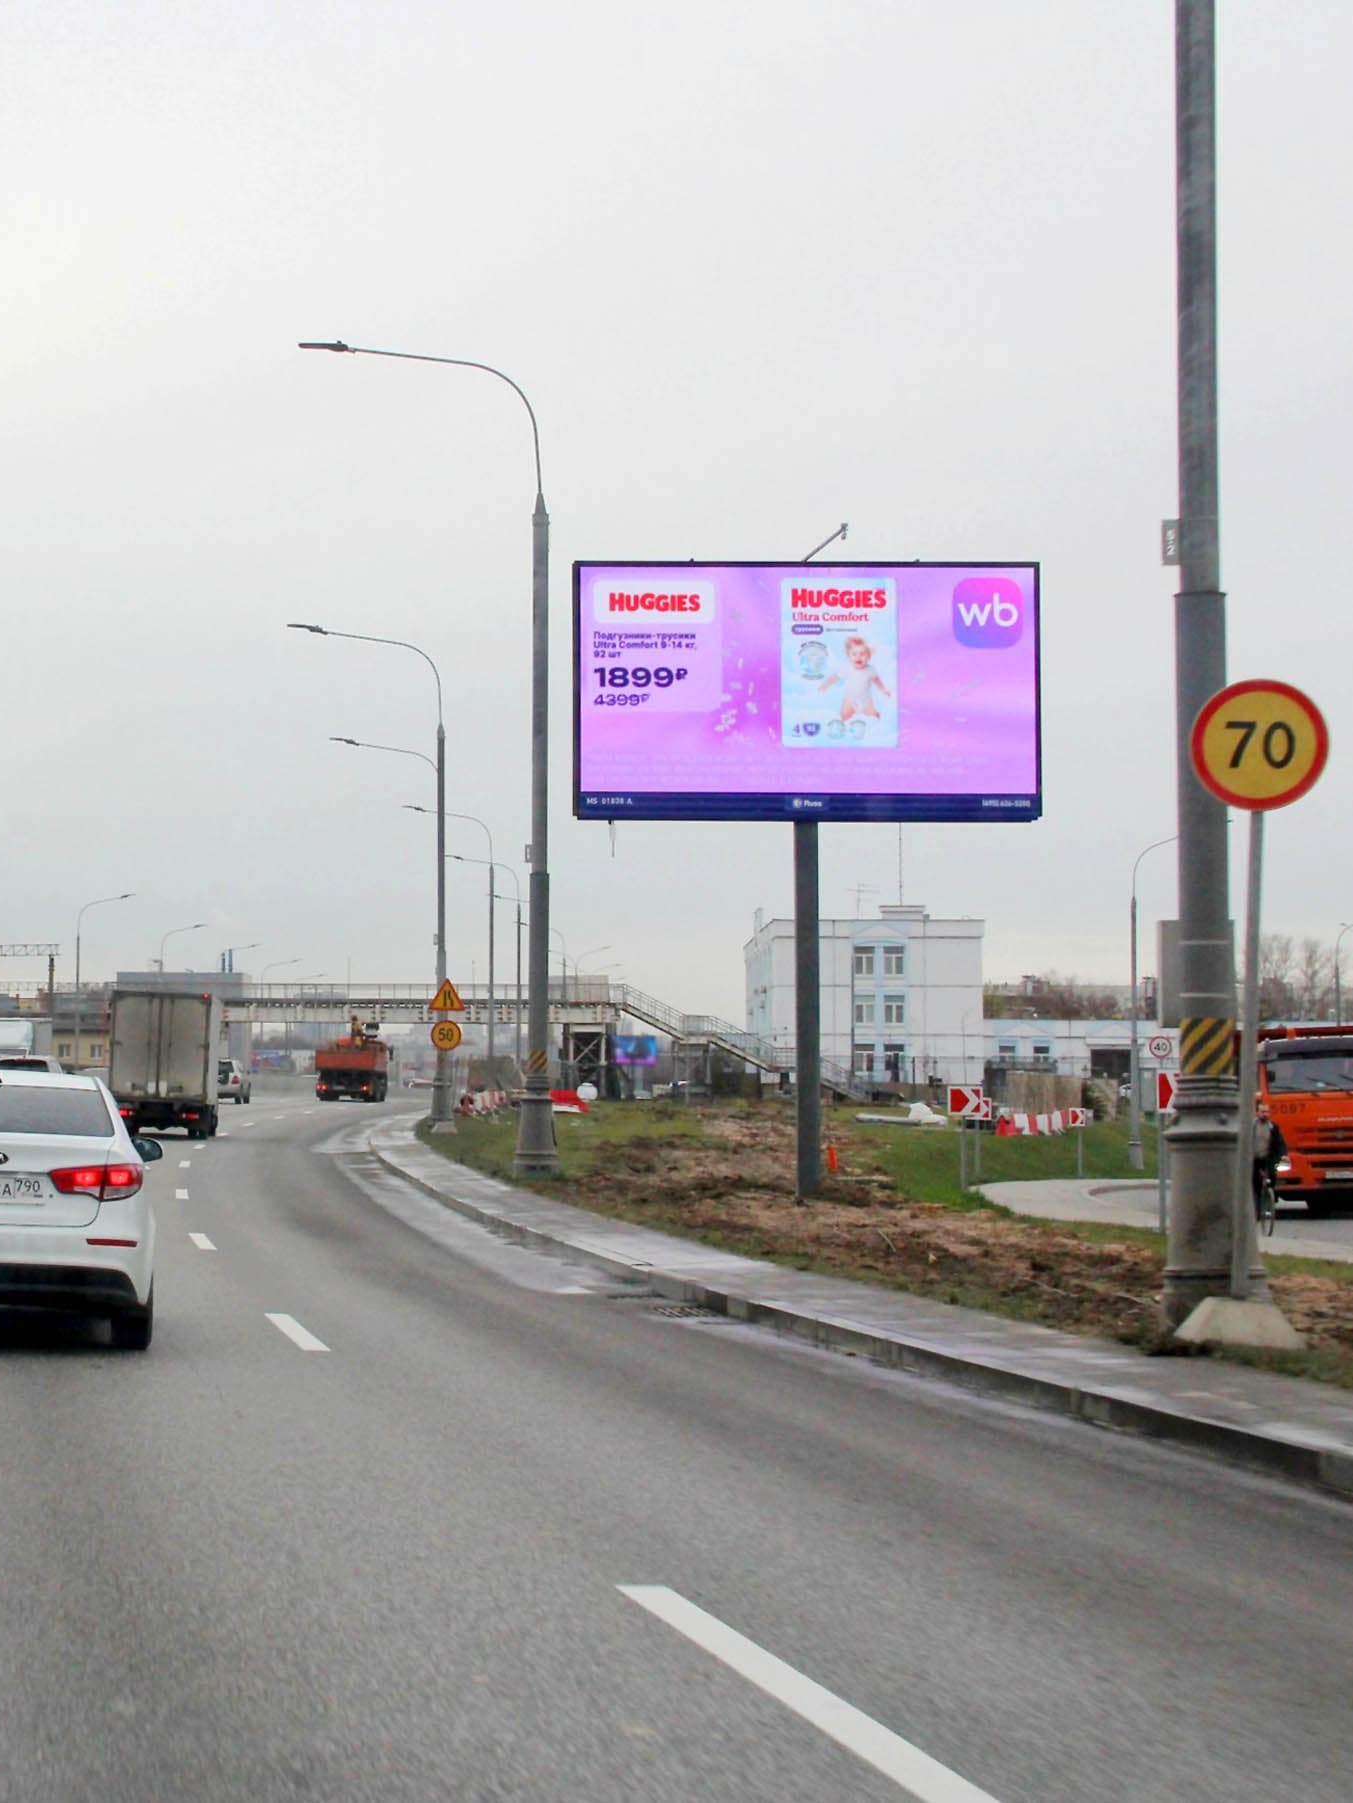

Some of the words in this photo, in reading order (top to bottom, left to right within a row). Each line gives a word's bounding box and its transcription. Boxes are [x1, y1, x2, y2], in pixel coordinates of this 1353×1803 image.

[609, 592, 701, 612] HUGGIES
[791, 588, 887, 609] HUGGIES
[957, 592, 1019, 627] wb
[792, 612, 820, 622] Ultra
[822, 612, 870, 622] Comfort
[593, 631, 696, 641] Подгузники-трусики
[593, 641, 617, 649] Ultra
[619, 641, 659, 649] Comfort
[593, 650, 606, 658] 92
[1225, 721, 1296, 769] 70
[438, 1027, 454, 1042] 50
[1154, 1042, 1168, 1052] 40
[14, 1179, 41, 1193] 790
